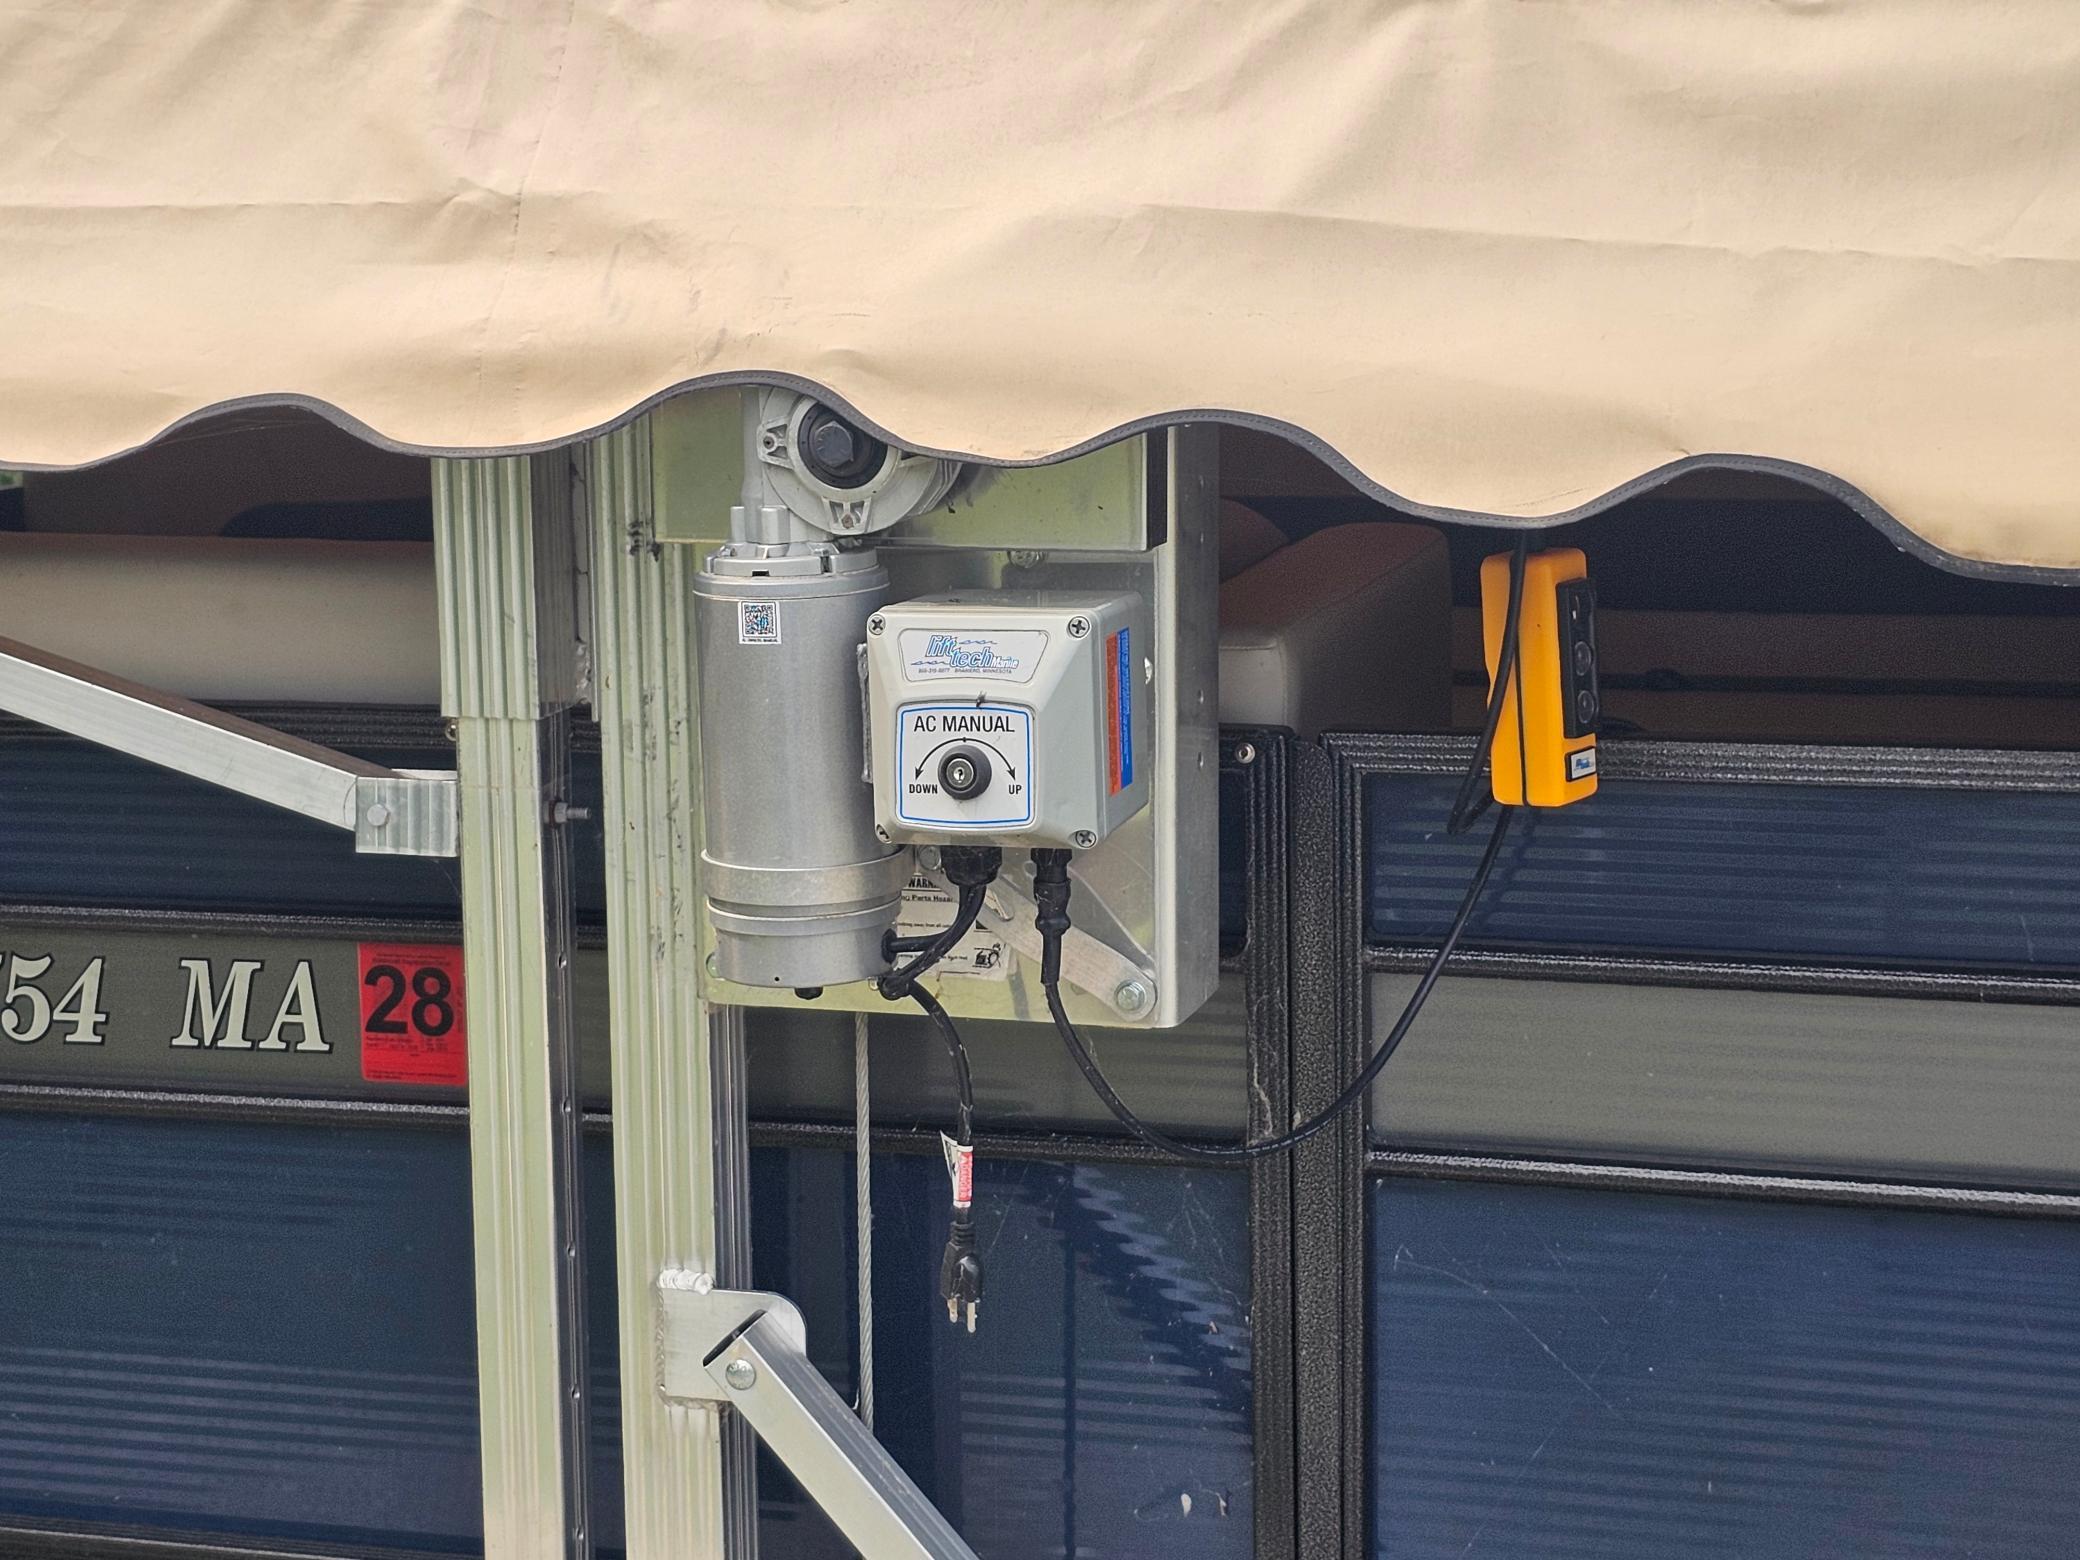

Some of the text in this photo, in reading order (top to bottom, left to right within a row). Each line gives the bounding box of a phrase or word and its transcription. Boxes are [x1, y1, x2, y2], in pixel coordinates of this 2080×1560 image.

[925, 635, 957, 657] lift
[949, 646, 994, 668] tech
[914, 715, 1015, 733] AC MANUAL
[909, 784, 1022, 795] DOWN UP
[0, 951, 333, 1053] 54 MA
[364, 964, 454, 1037] 28
